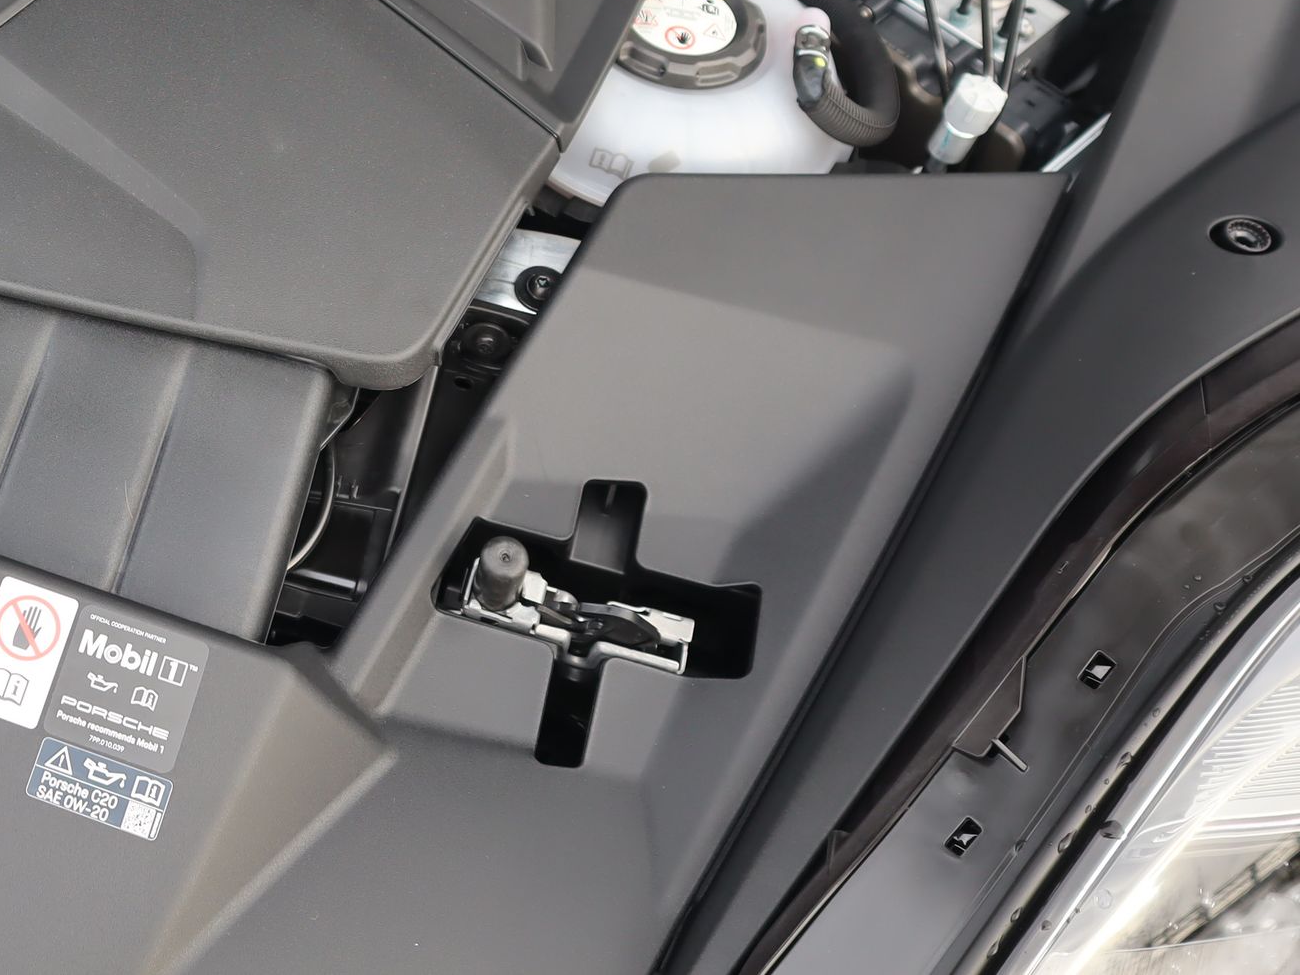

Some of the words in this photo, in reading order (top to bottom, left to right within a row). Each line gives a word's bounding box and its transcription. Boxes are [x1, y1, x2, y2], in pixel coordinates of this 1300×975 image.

[90, 613, 111, 626] OFFICIAL
[111, 619, 144, 636] COOPERATION
[144, 630, 167, 644] PARTNER
[78, 628, 158, 676] Mobil
[56, 709, 86, 728] Porsche
[87, 721, 136, 744] recommends
[136, 737, 159, 753] Mobil
[159, 745, 165, 754] 1
[60, 694, 170, 741] PORSCHE
[36, 785, 64, 805] SAE
[63, 794, 109, 822] 0W-20
[41, 770, 89, 799] Porsche
[91, 789, 118, 810] C20
